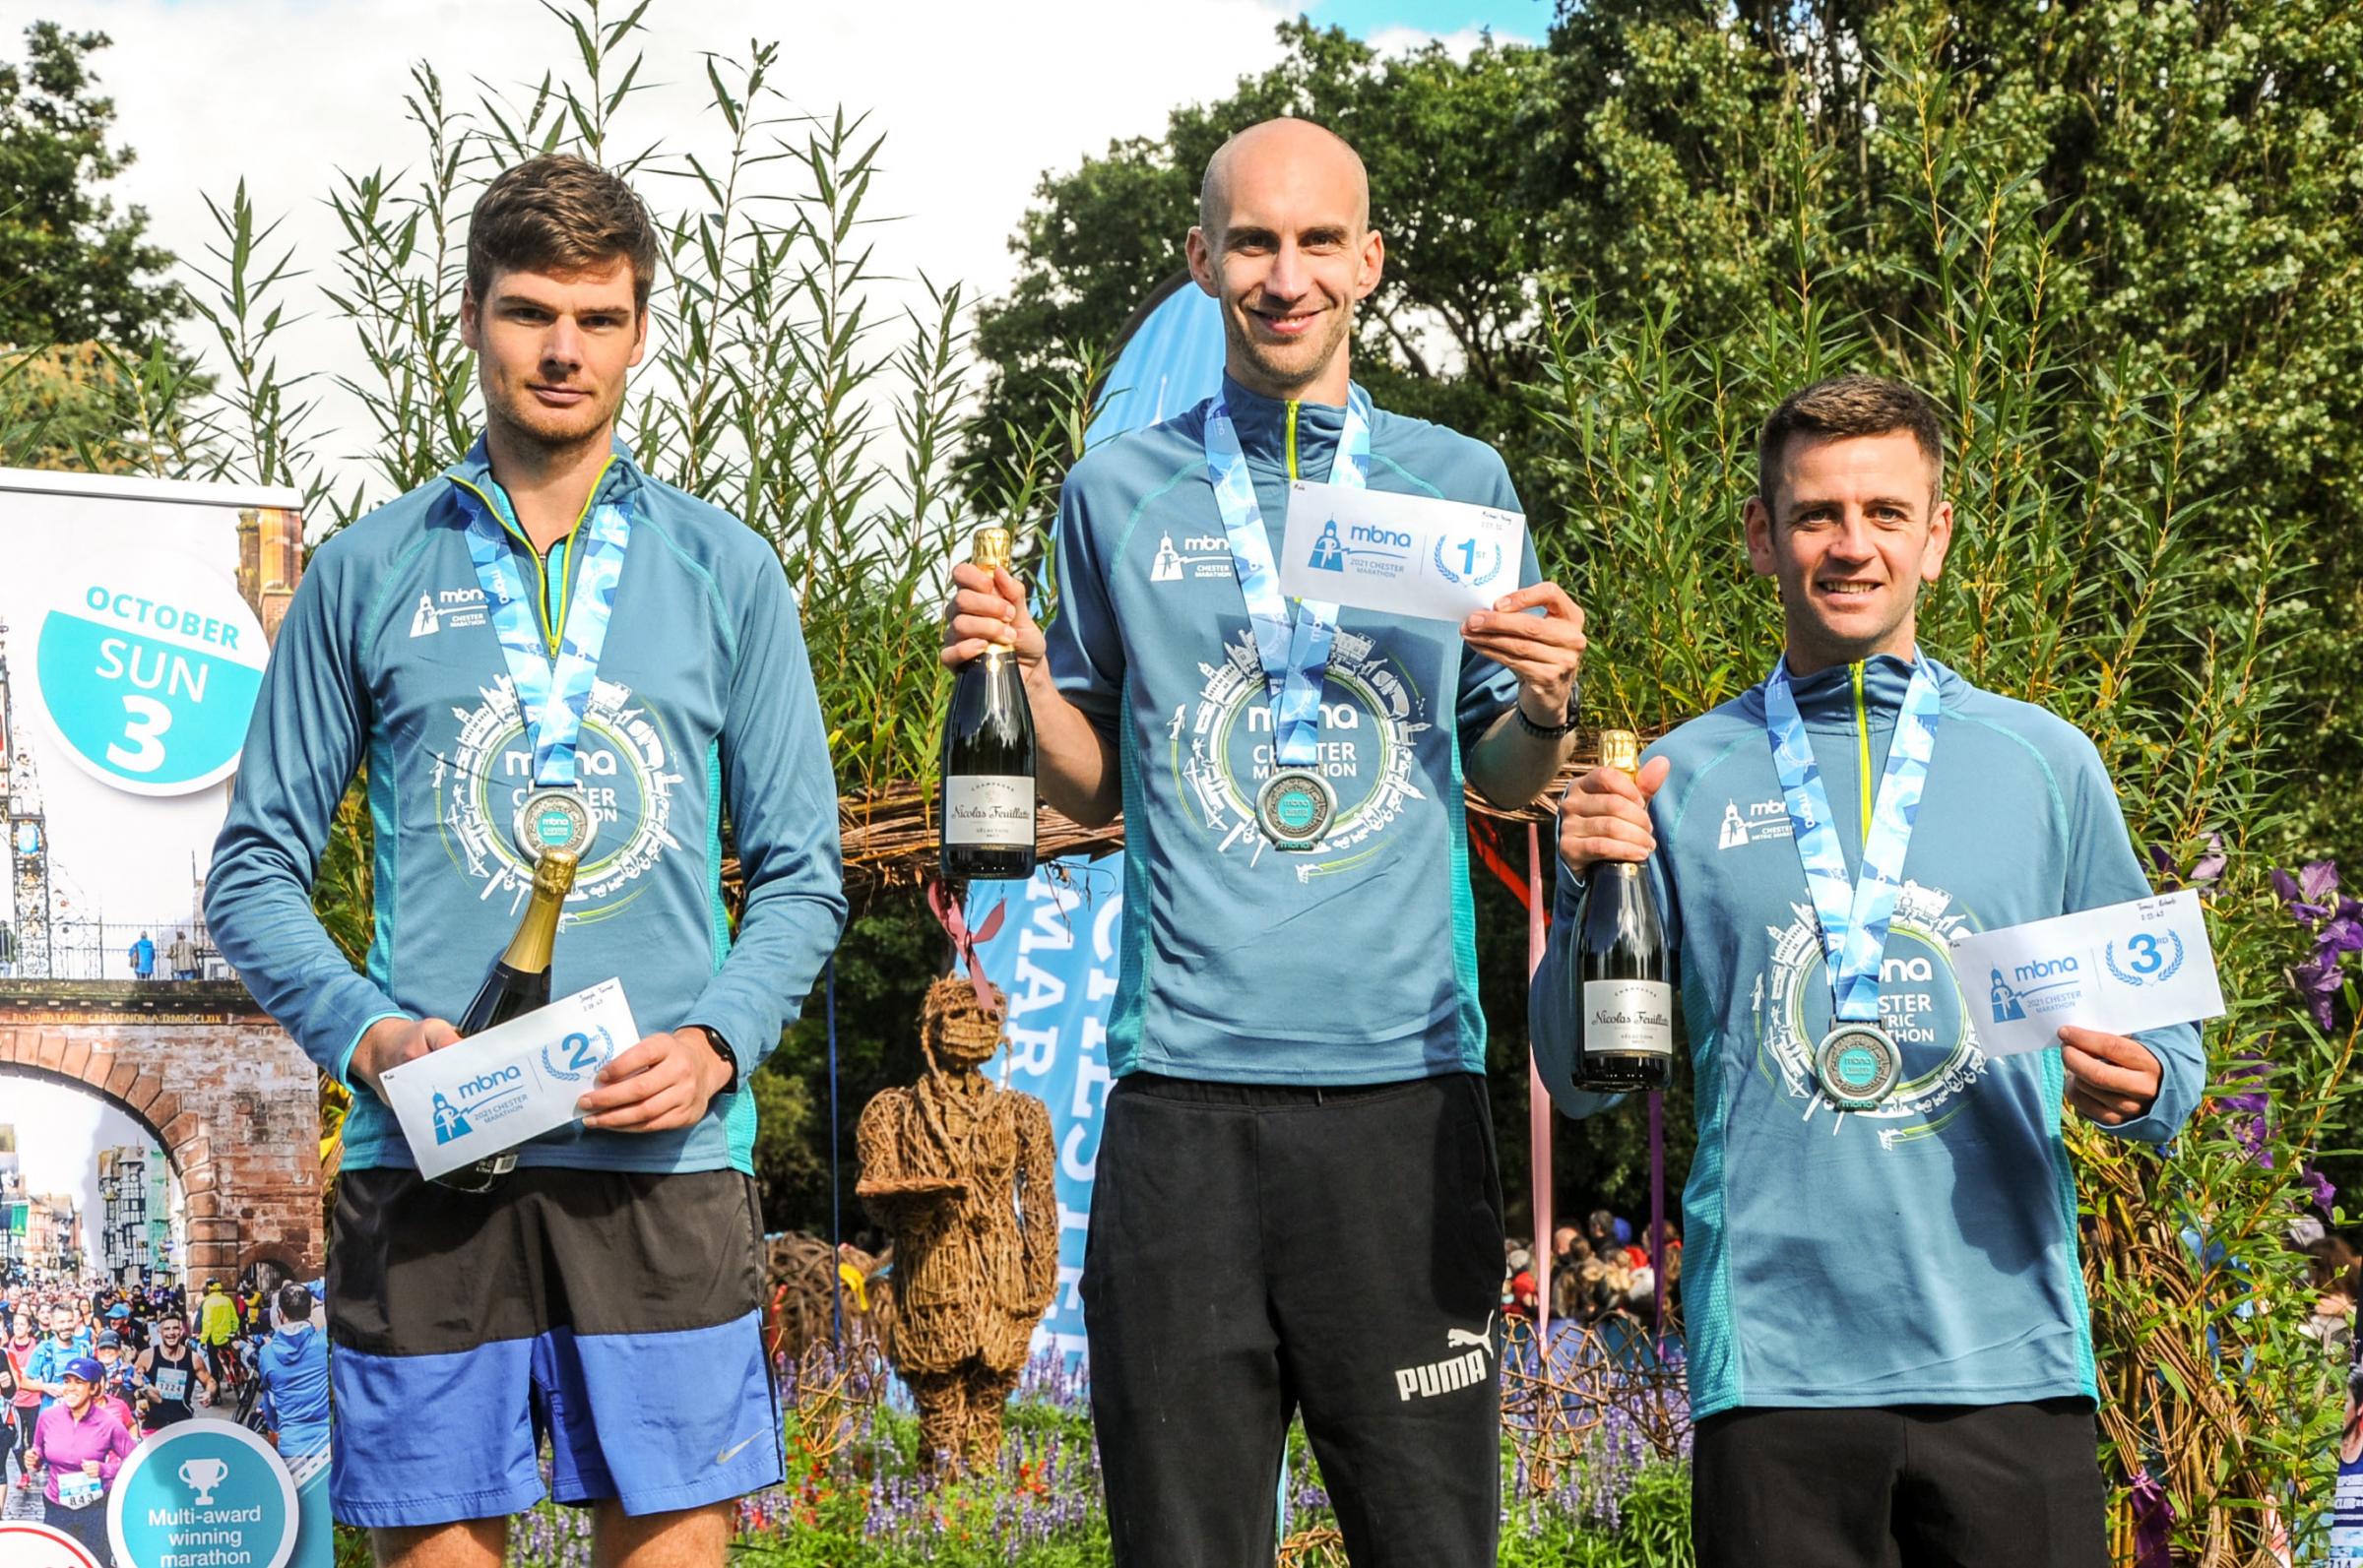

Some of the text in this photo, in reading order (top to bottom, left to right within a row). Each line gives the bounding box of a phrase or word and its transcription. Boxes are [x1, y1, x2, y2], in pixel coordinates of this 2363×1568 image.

[1185, 535, 1231, 551] mbn
[1351, 525, 1411, 548] mbna
[1350, 558, 1405, 574] 2021 CHESTER
[1357, 567, 1396, 580] MARATHON
[440, 589, 485, 603] mbn
[86, 586, 239, 651] OCTOBER
[452, 613, 483, 622] CHESTER
[96, 637, 209, 704] SUN
[1248, 703, 1359, 732] mna
[105, 694, 173, 773] 3
[505, 750, 617, 777] mna
[951, 804, 987, 819] Nicolas
[1761, 825, 1792, 835] CHESTE
[2014, 956, 2079, 982] mbna
[2027, 990, 2082, 1009] 2021 CHESTER
[2035, 1000, 2076, 1014] MARATHON
[1591, 1010, 1631, 1025] Nicolas
[458, 1065, 522, 1099] mbna
[474, 1093, 529, 1122] 2021 CHESTER
[483, 1104, 524, 1124] MARATHON
[1395, 1348, 1487, 1402] PUMA
[70, 1492, 95, 1506] 843
[149, 1505, 262, 1527] Multi-award
[167, 1528, 242, 1548] winning
[160, 1548, 251, 1568] marathon
